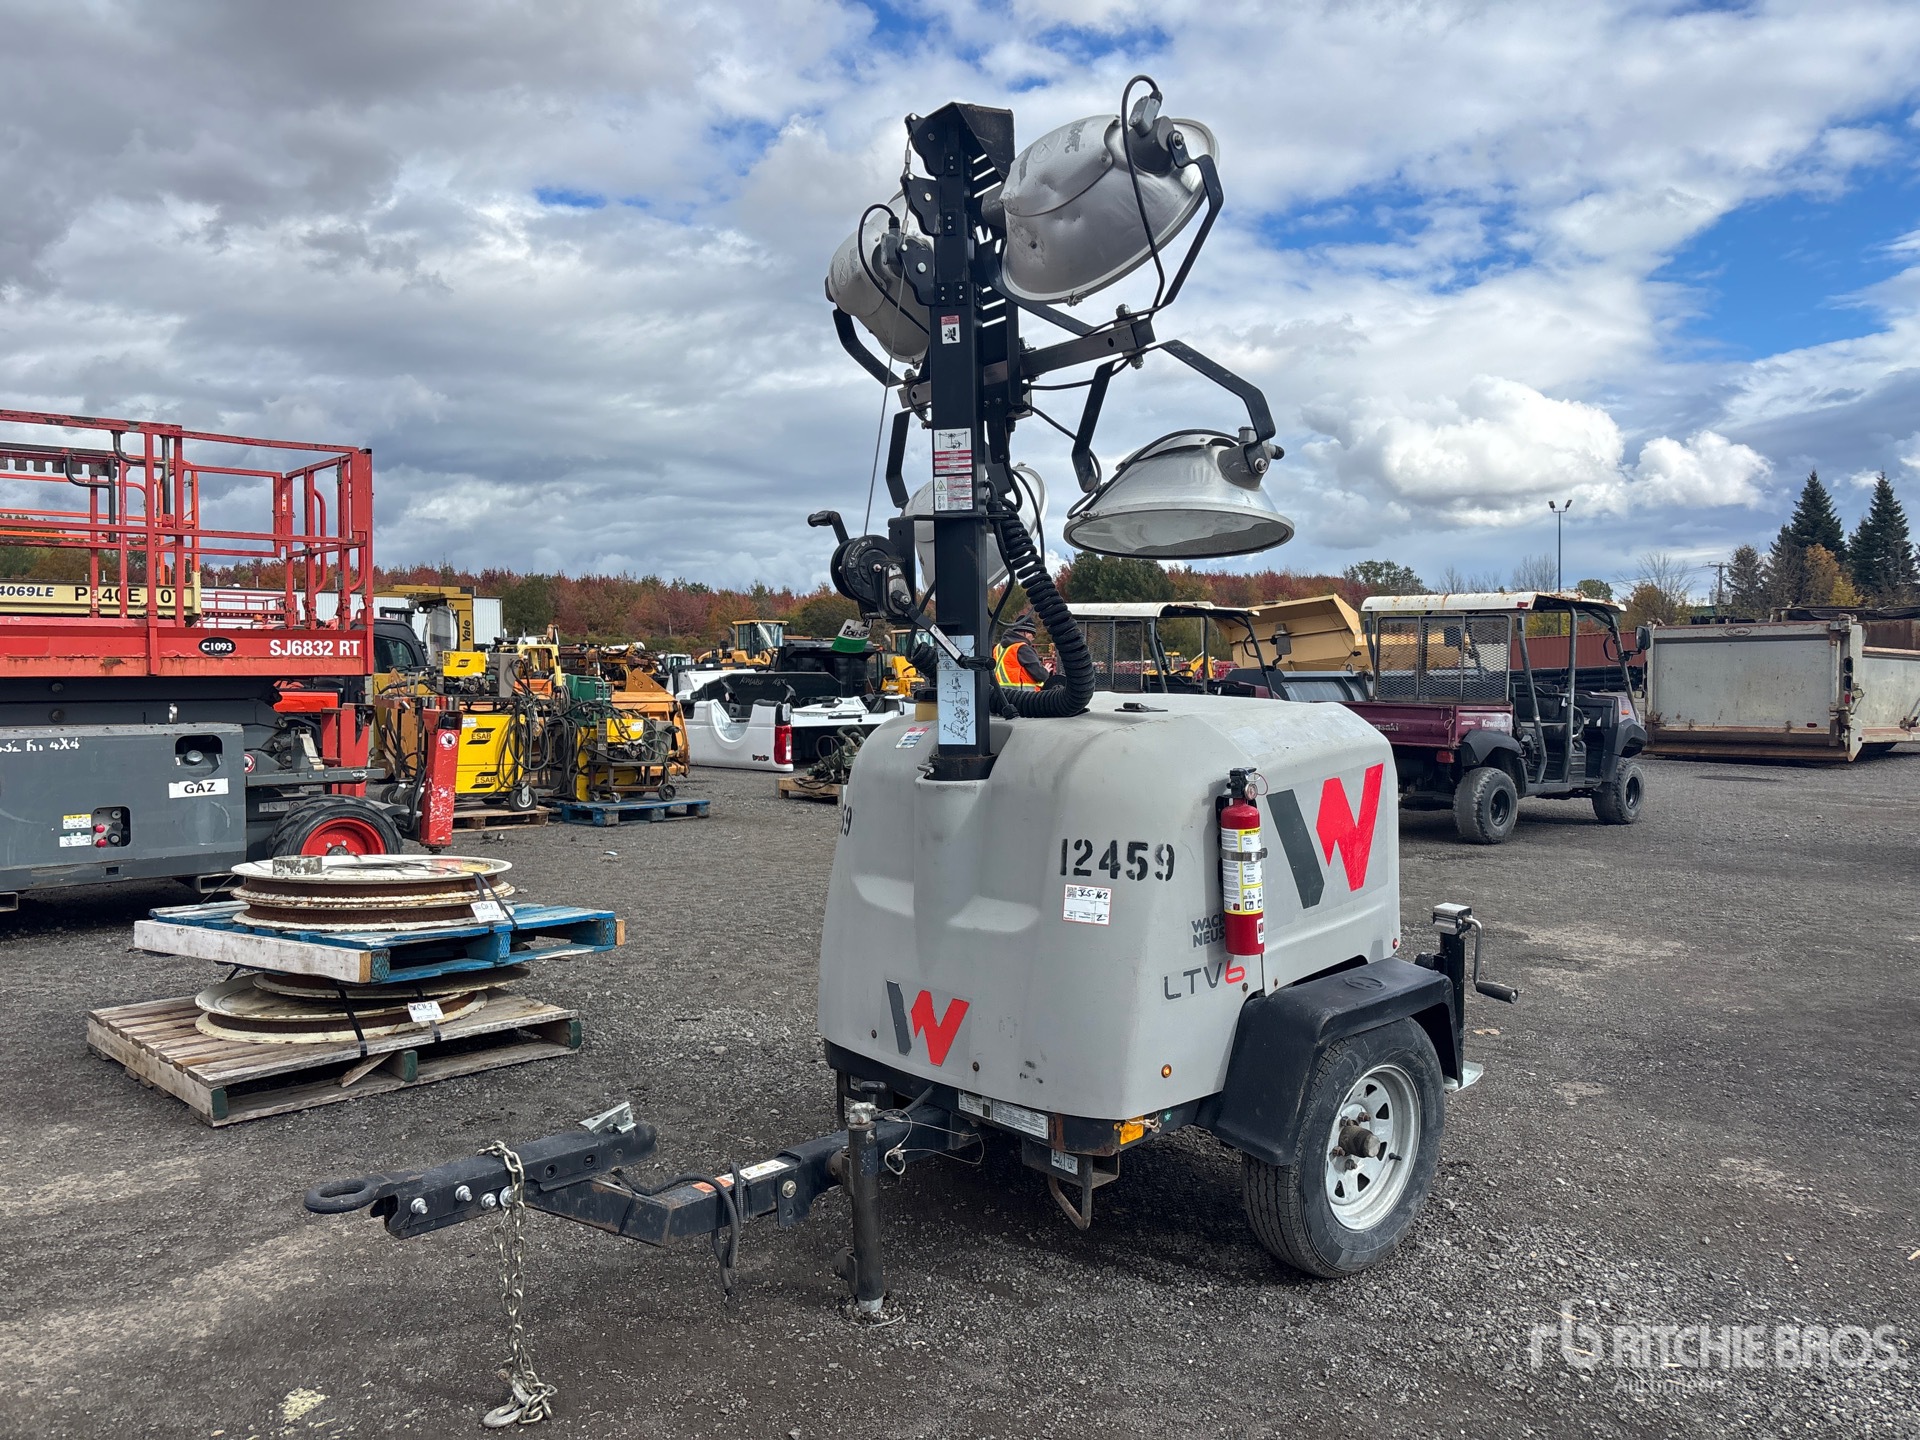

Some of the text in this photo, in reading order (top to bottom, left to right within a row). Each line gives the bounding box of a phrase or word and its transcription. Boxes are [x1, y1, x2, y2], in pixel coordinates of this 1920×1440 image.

[463, 619, 471, 642] Yale
[269, 639, 361, 656] SJ6832 RT
[471, 732, 492, 740] ESAB
[184, 782, 216, 794] GAZ
[475, 776, 496, 784] ESAB
[1060, 838, 1175, 881] 12459
[1164, 960, 1246, 1000] LTV6
